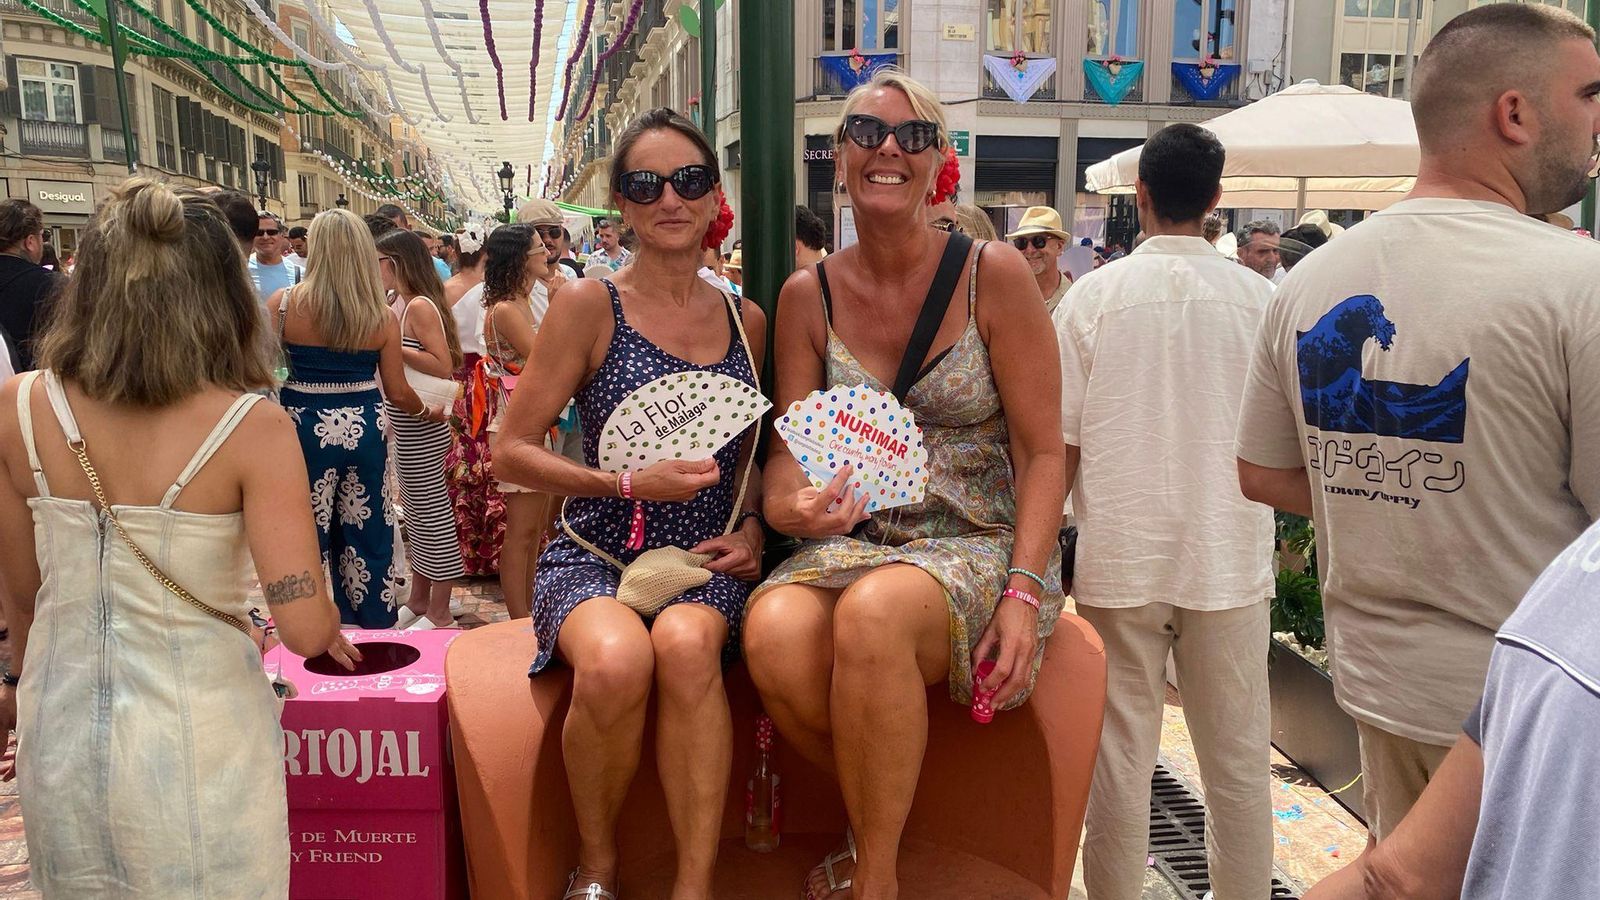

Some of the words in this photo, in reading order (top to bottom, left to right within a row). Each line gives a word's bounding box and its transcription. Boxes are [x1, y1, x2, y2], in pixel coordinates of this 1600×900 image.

[615, 421, 646, 441] La
[643, 392, 687, 426] Flor
[655, 426, 669, 438] de
[667, 401, 708, 430] Málaga
[835, 409, 908, 460] NURIMAR
[1324, 484, 1370, 497] EDWIN
[302, 832, 327, 844] DE
[333, 829, 418, 844] MUERTE
[309, 849, 383, 864] FRIEND
